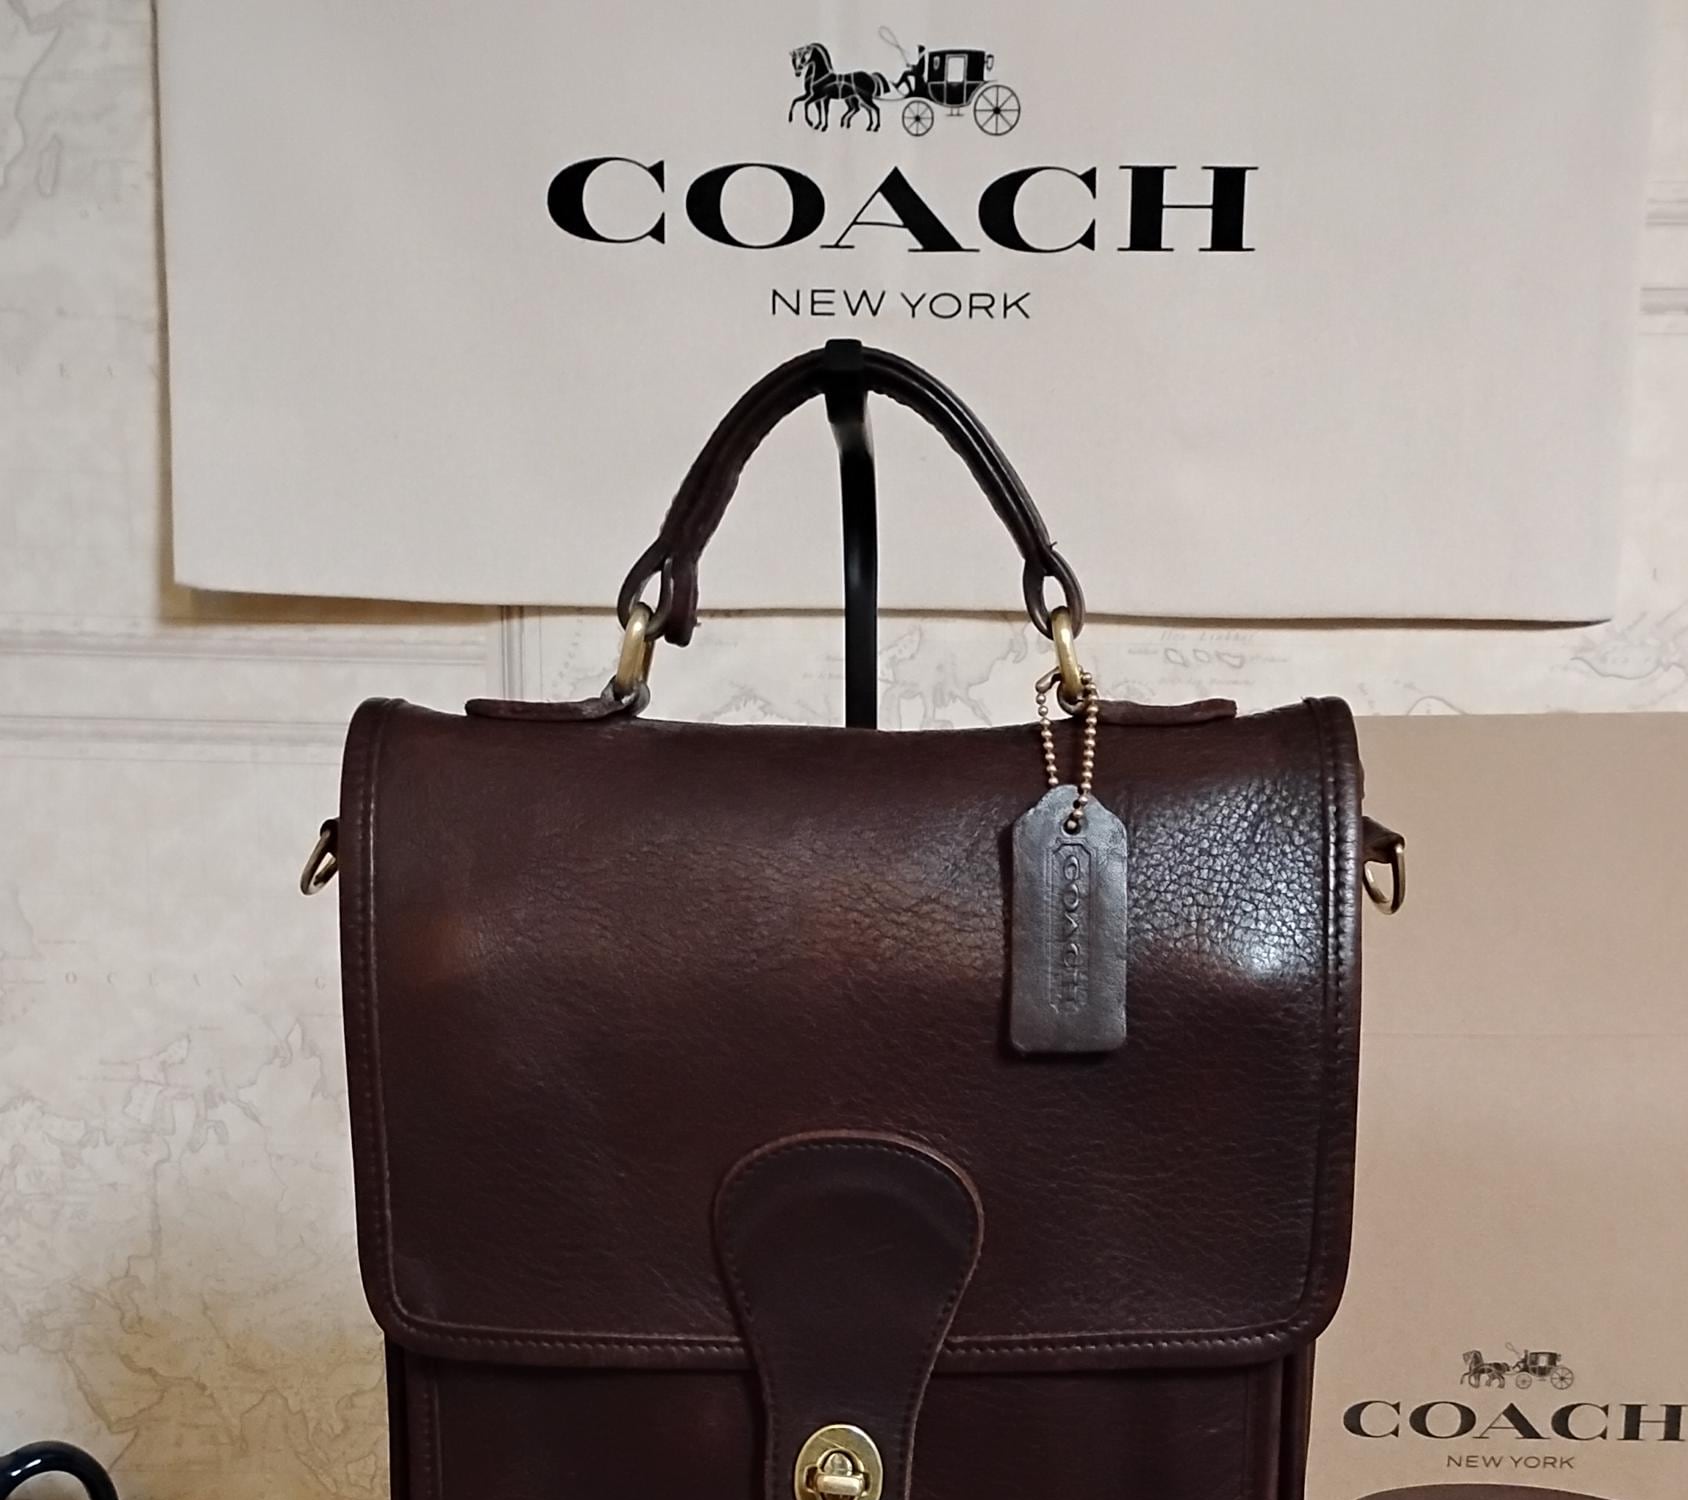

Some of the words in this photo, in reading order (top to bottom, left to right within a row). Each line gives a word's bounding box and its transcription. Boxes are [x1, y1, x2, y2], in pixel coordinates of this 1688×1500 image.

[547, 156, 1259, 254] COACH
[771, 288, 886, 317] NEW
[900, 291, 1032, 320] YORK
[1063, 854, 1081, 1002] COACH
[1343, 1400, 1688, 1442] COACH
[1446, 1454, 1503, 1469] NEW
[1508, 1455, 1575, 1470] YORK
